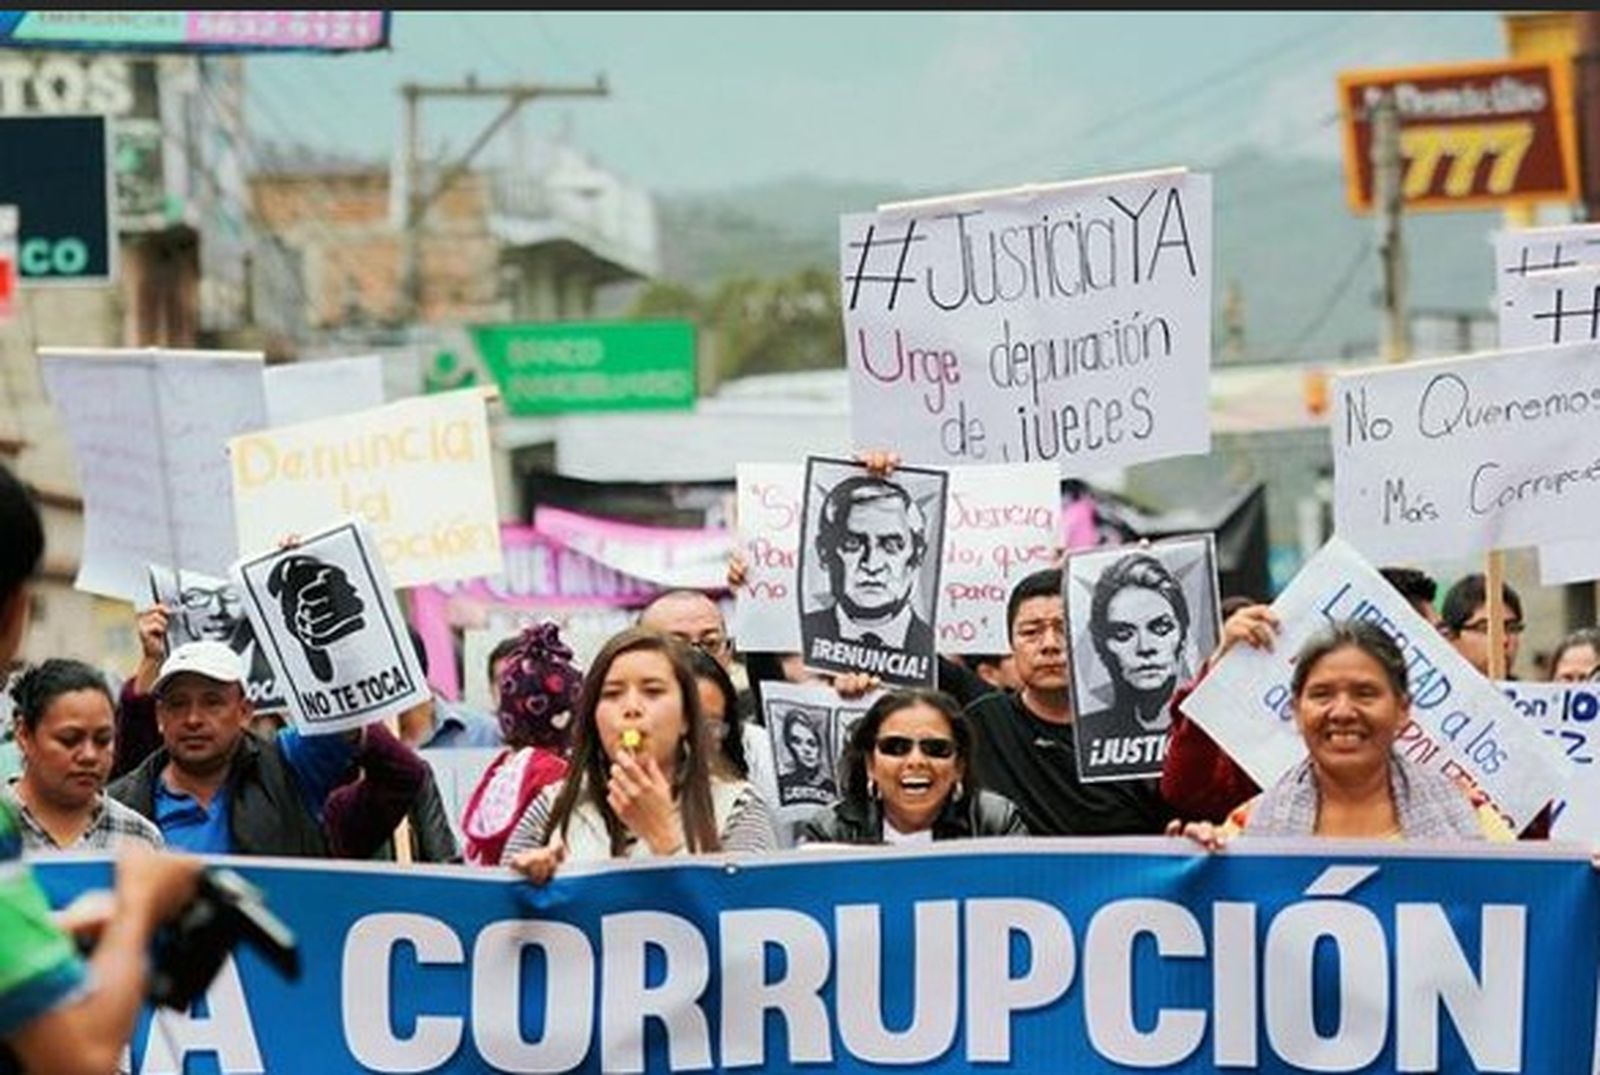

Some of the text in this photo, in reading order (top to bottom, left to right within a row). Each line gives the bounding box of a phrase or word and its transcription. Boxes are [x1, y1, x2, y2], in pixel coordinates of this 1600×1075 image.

[1402, 122, 1536, 198] 777
[858, 312, 1171, 414] Urge depuración
[941, 401, 986, 462] de
[1345, 386, 1393, 446] No
[993, 545, 1053, 578] que
[811, 637, 929, 680] ¡RENUNCIA!
[302, 665, 408, 717] NO TE TOCA
[1440, 710, 1471, 742] a
[1464, 720, 1508, 776] los
[115, 952, 266, 1074] A
[341, 865, 1528, 1074] CORRUPCIÓN
